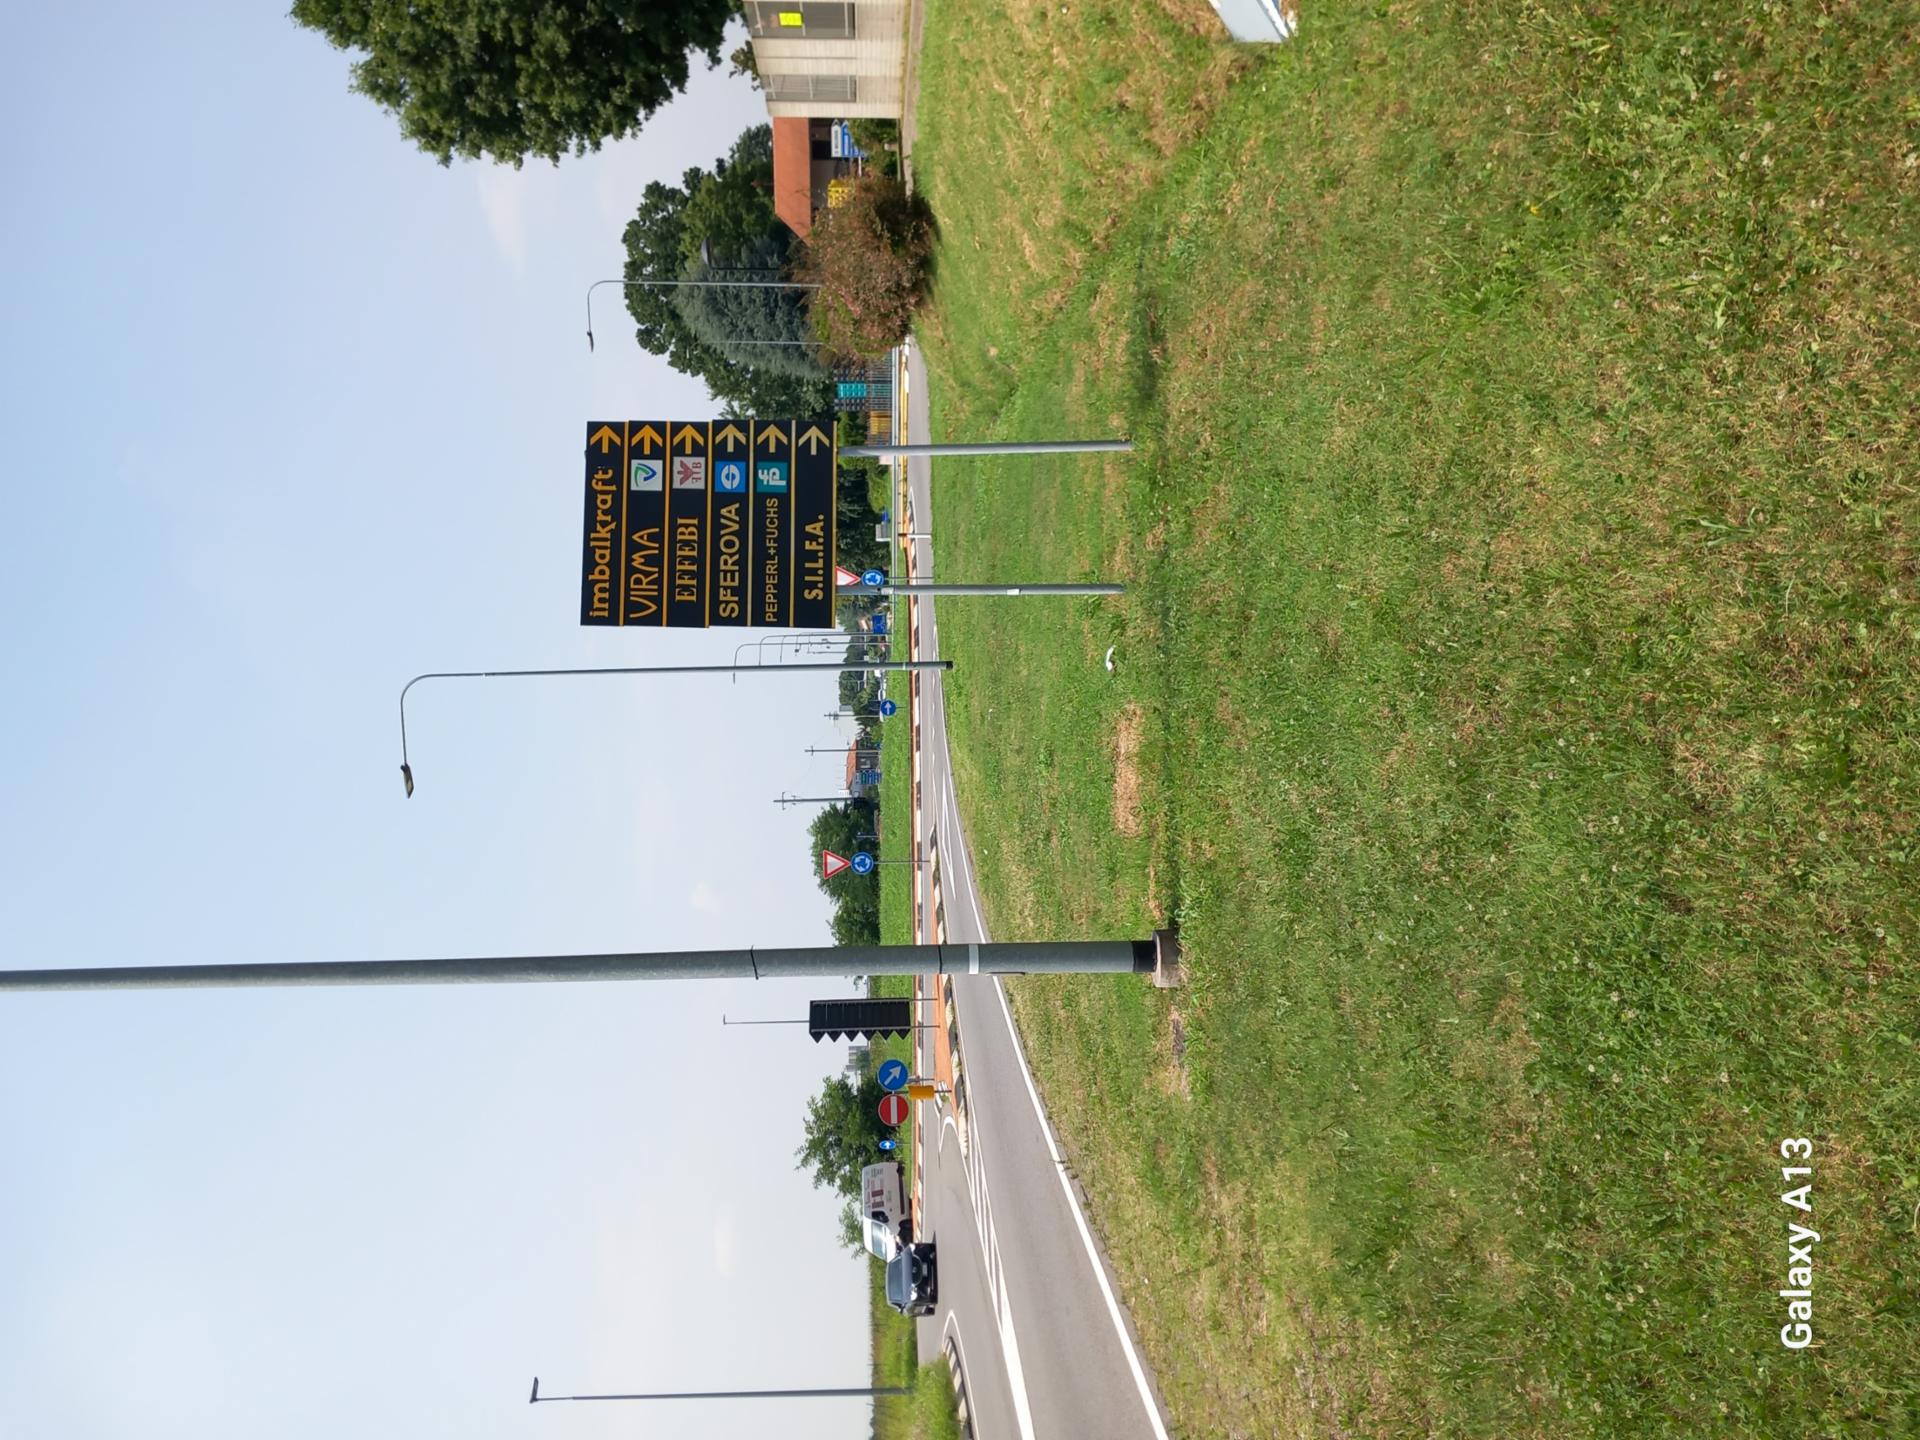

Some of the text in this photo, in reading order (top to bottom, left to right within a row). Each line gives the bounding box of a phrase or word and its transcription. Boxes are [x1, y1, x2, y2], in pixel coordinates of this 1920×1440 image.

[588, 468, 617, 618] imbalkraft
[629, 528, 660, 618] VIRMA
[675, 517, 698, 603] EFFEBI
[719, 502, 740, 618] SFEROVA
[765, 497, 778, 622] PEPPERL+FUCHS
[803, 514, 825, 600] S.I.L.F.A.
